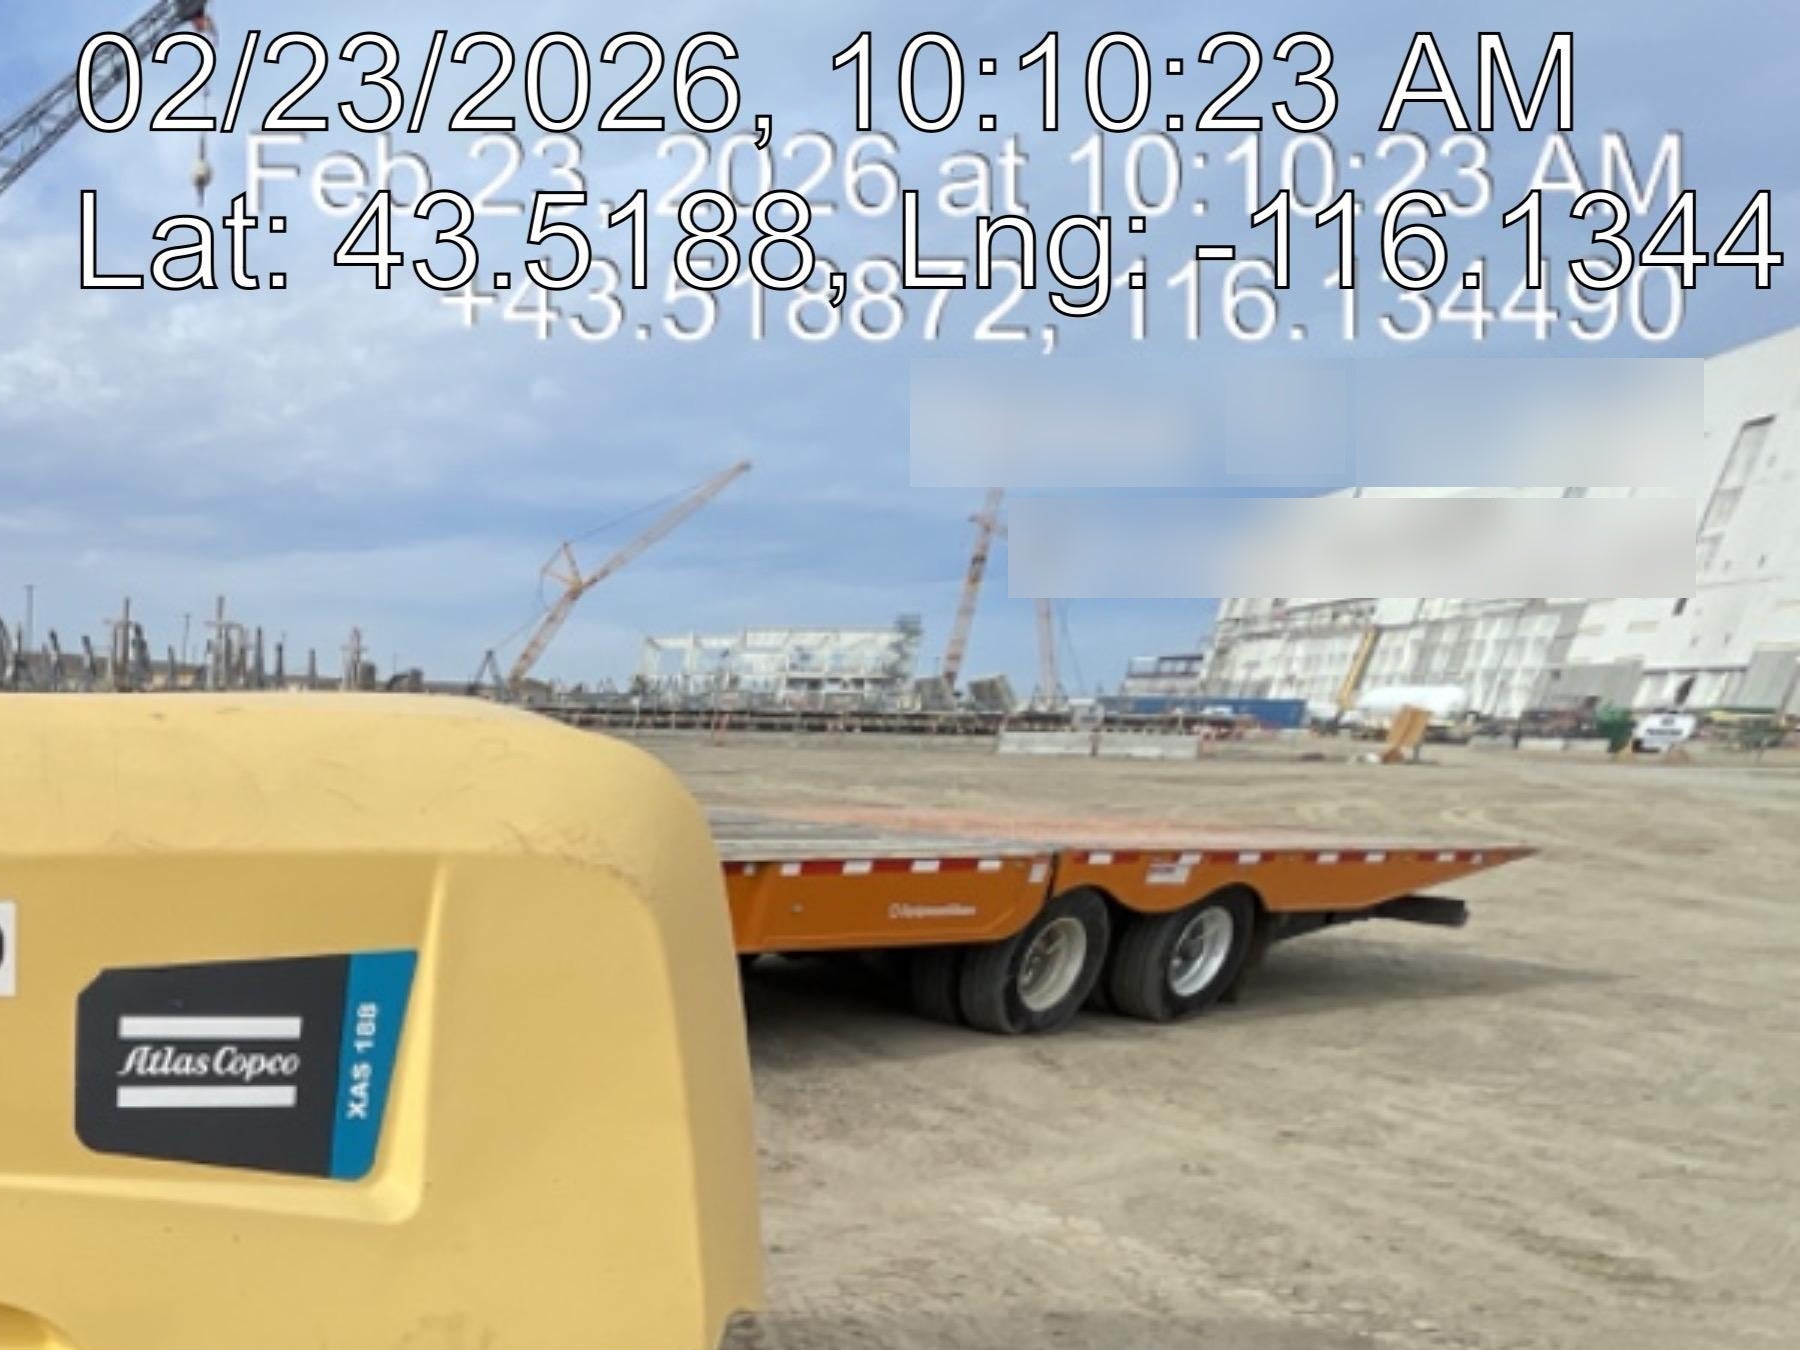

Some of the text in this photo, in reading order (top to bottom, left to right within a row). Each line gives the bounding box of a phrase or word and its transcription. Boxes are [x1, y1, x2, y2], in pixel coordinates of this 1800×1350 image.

[116, 1045, 301, 1083] Atlas Copco
[346, 1062, 372, 1120] XAS
